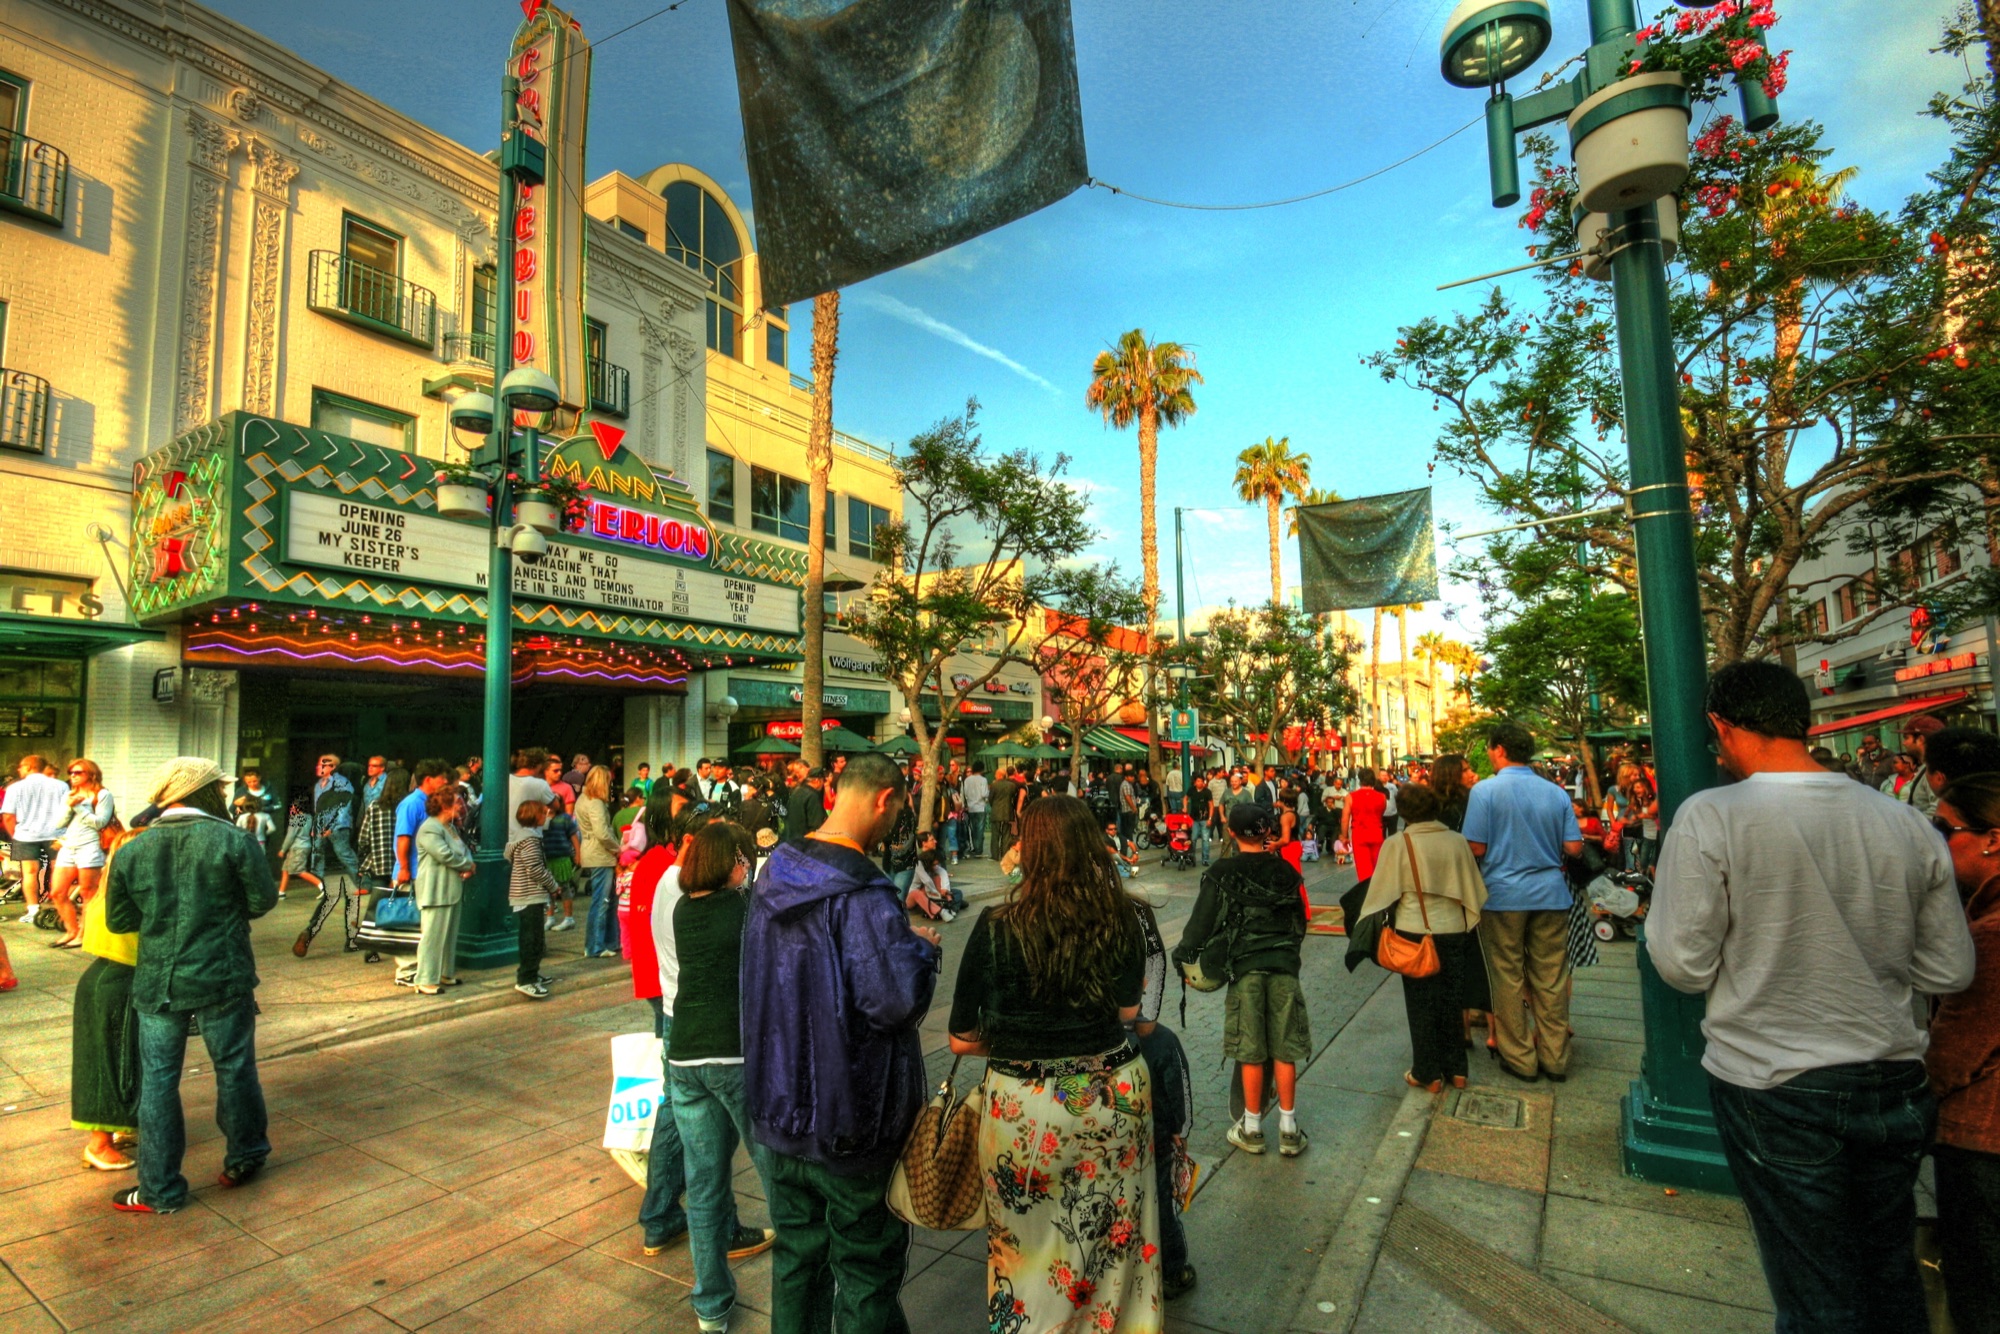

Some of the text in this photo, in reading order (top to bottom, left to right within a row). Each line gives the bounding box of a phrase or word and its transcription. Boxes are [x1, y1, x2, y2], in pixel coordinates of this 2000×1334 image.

[551, 454, 655, 502] MANN
[340, 503, 405, 528] OPENING
[342, 520, 402, 543] JUNE 26
[319, 531, 419, 560] MY SISTER'S
[546, 544, 618, 568] WAY WE GO
[343, 552, 400, 573] KEEPER
[590, 565, 618, 580] THAT
[514, 565, 634, 595] ANGELS AND DEMONS
[724, 578, 756, 594] OPENING
[514, 578, 527, 592] FE
[533, 581, 545, 594] IN
[552, 584, 585, 600] RUINS
[601, 592, 664, 612] TERMINATOR
[726, 590, 754, 605] JUNE 19
[730, 602, 749, 614] YEAR
[732, 613, 747, 625] ONE
[830, 655, 873, 673] Wolfgang
[611, 1098, 652, 1124] OLD
